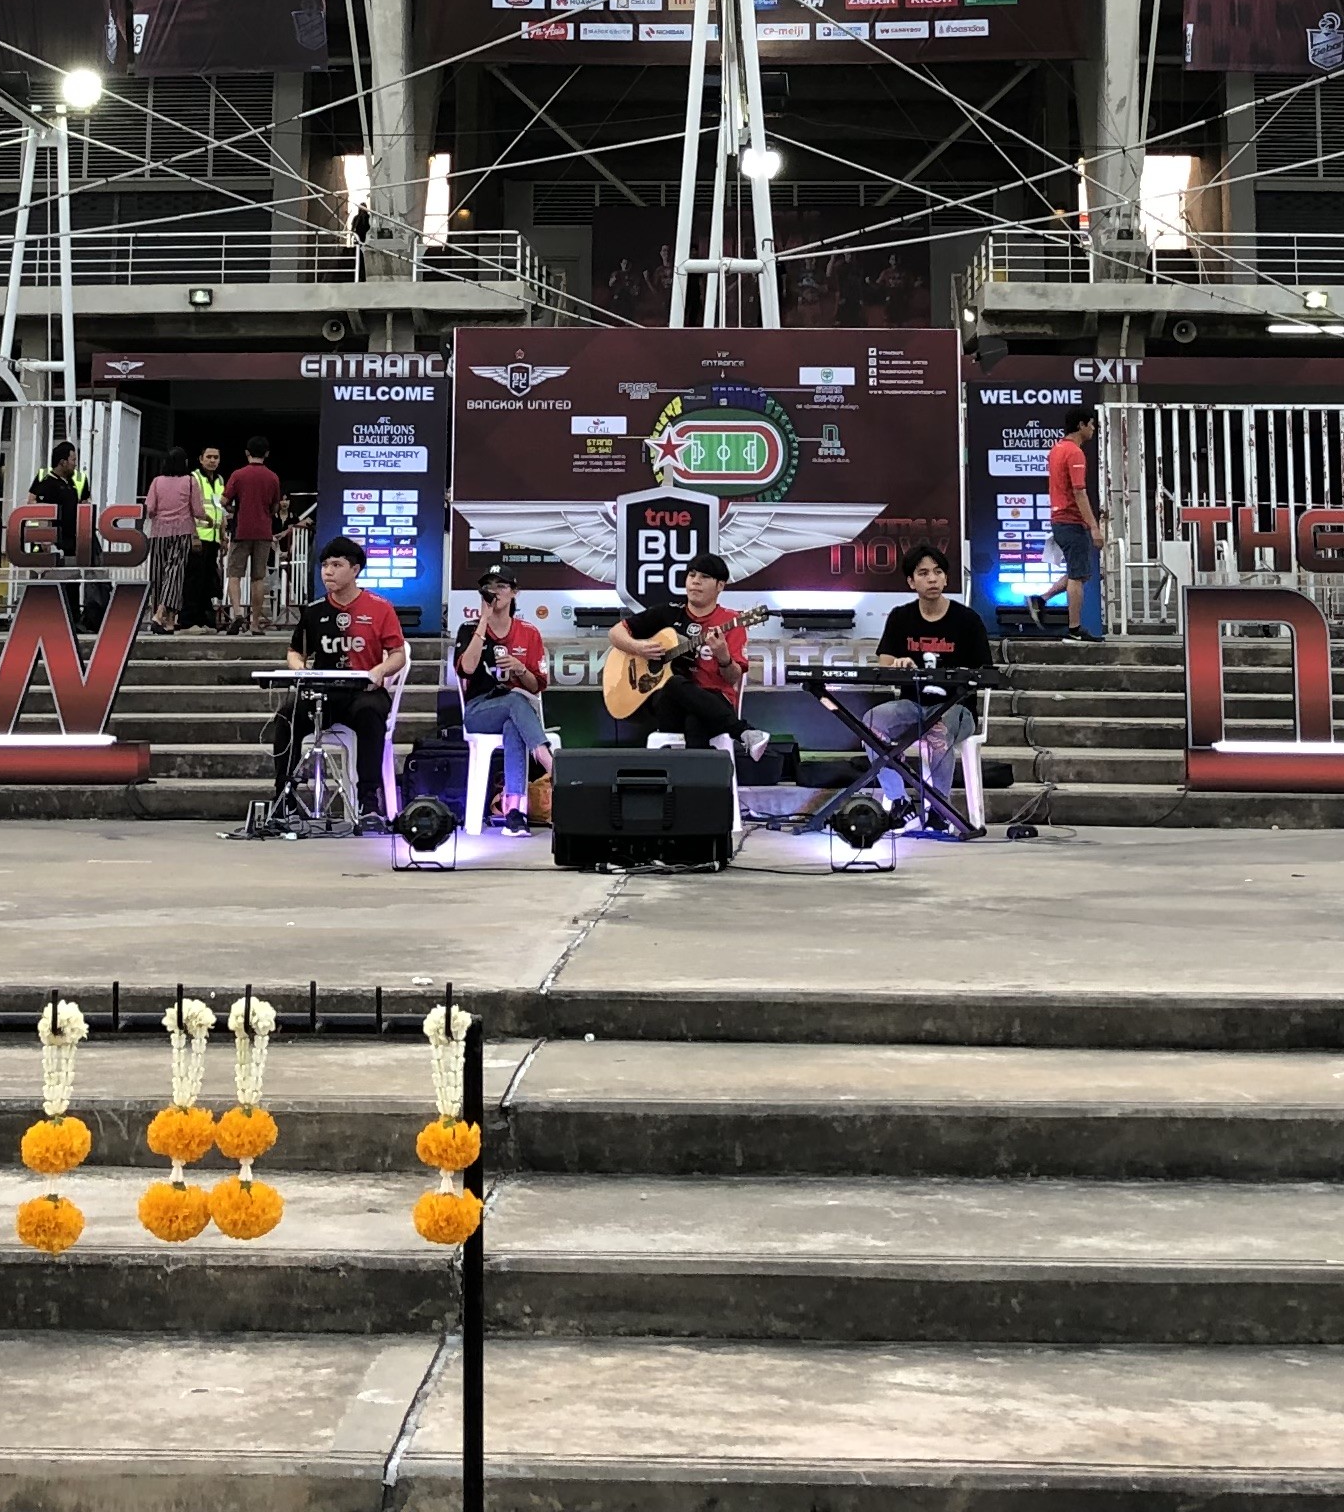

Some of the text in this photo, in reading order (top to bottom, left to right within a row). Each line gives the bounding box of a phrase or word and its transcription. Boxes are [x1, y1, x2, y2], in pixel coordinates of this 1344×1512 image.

[763, 26, 804, 38] CP-meiji
[512, 372, 528, 381] BU
[1073, 358, 1143, 384] EXIT
[512, 381, 528, 389] FC
[333, 386, 434, 401] WELCOME
[980, 389, 1083, 405] WELCOME
[467, 400, 572, 410] BANGKOK UNITED
[377, 416, 391, 424] AFC
[352, 424, 415, 436] CHAMPIONS
[1002, 428, 1065, 439] CHAMPIONS
[353, 434, 415, 445] LEAGUE 2019
[1003, 439, 1040, 448] LEAGUE
[345, 450, 420, 460] PRELIMINARY
[995, 454, 1049, 463] PRELIMIN
[363, 459, 401, 469] STAGE
[350, 492, 373, 500] true
[1004, 496, 1026, 505] true
[645, 508, 692, 527] true
[77, 503, 152, 569] IS
[638, 529, 698, 561] BU
[463, 606, 482, 619] tru
[321, 635, 366, 653] true
[907, 638, 919, 652] The
